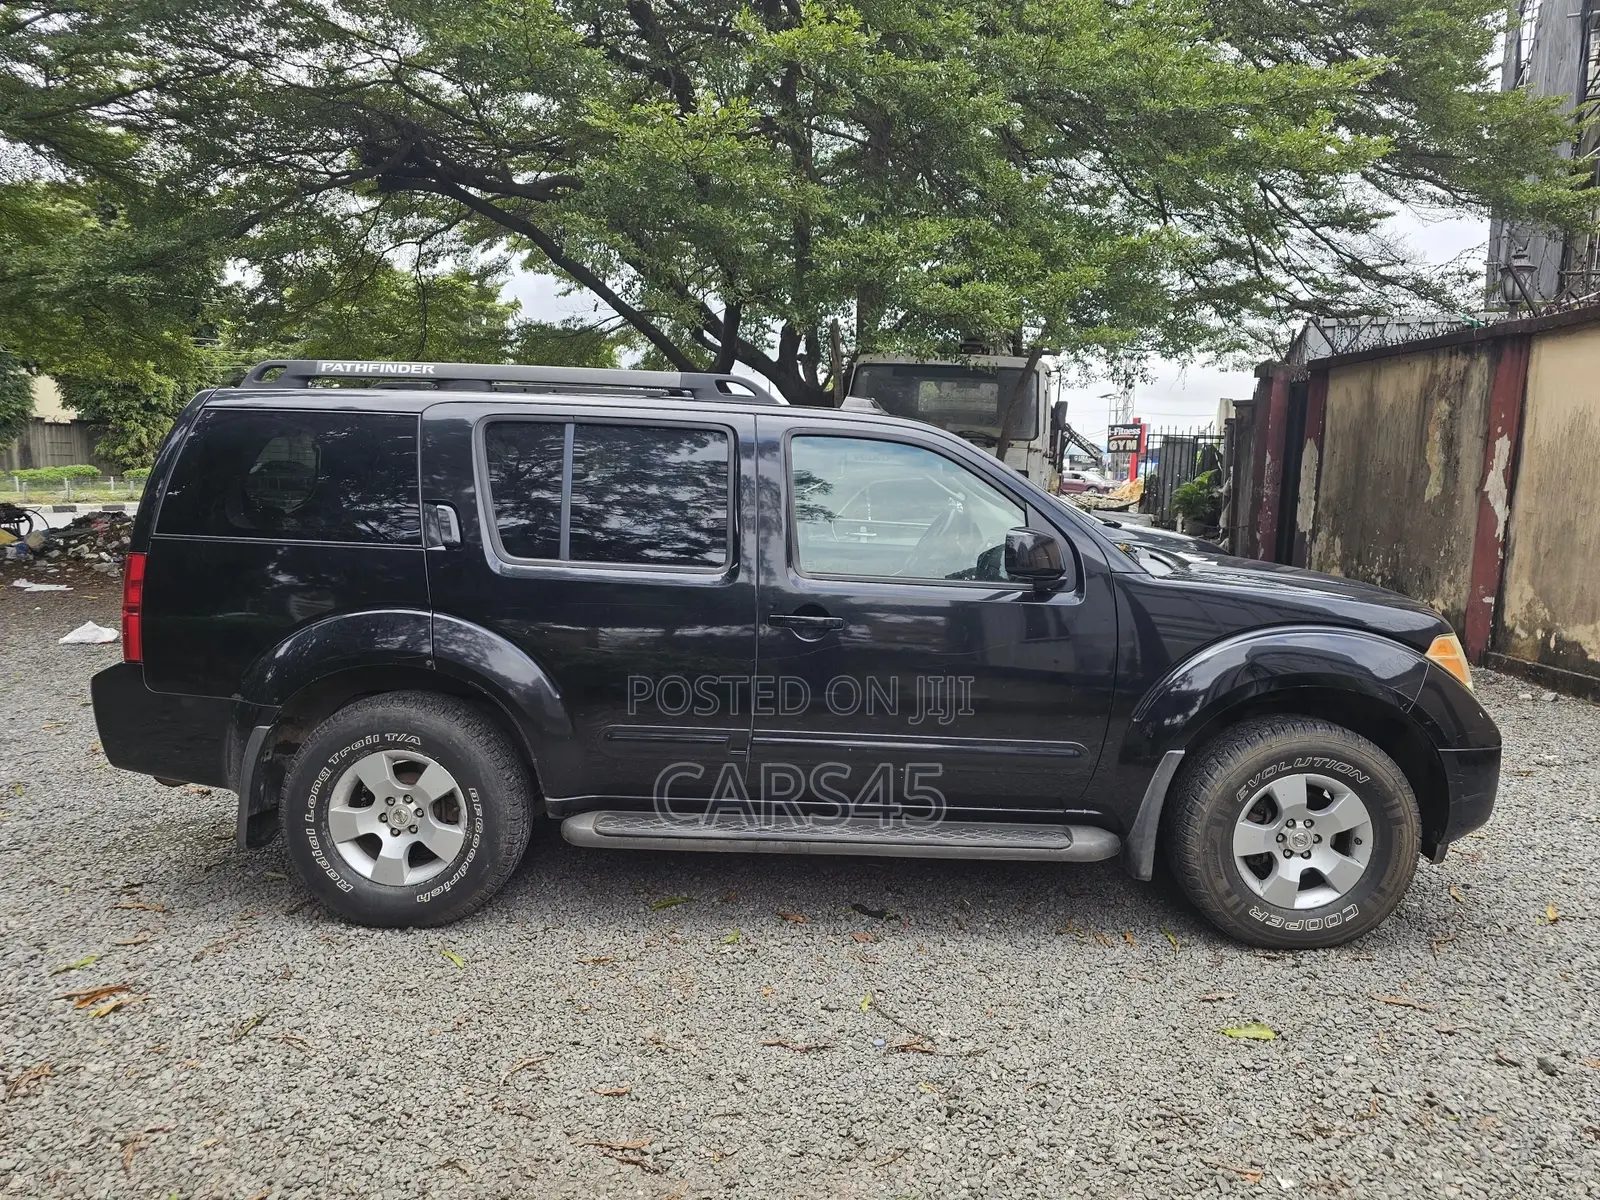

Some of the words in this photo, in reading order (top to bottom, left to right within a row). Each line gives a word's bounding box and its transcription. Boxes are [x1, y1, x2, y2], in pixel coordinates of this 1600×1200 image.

[320, 362, 435, 374] PATHFINDER
[1108, 440, 1138, 451] GYM
[328, 733, 380, 765] Trail
[385, 732, 422, 746] T/A
[304, 766, 332, 823] Long
[1235, 756, 1370, 803] EVOLUTION
[305, 828, 354, 893] Radial
[1248, 903, 1360, 932] COOPER
